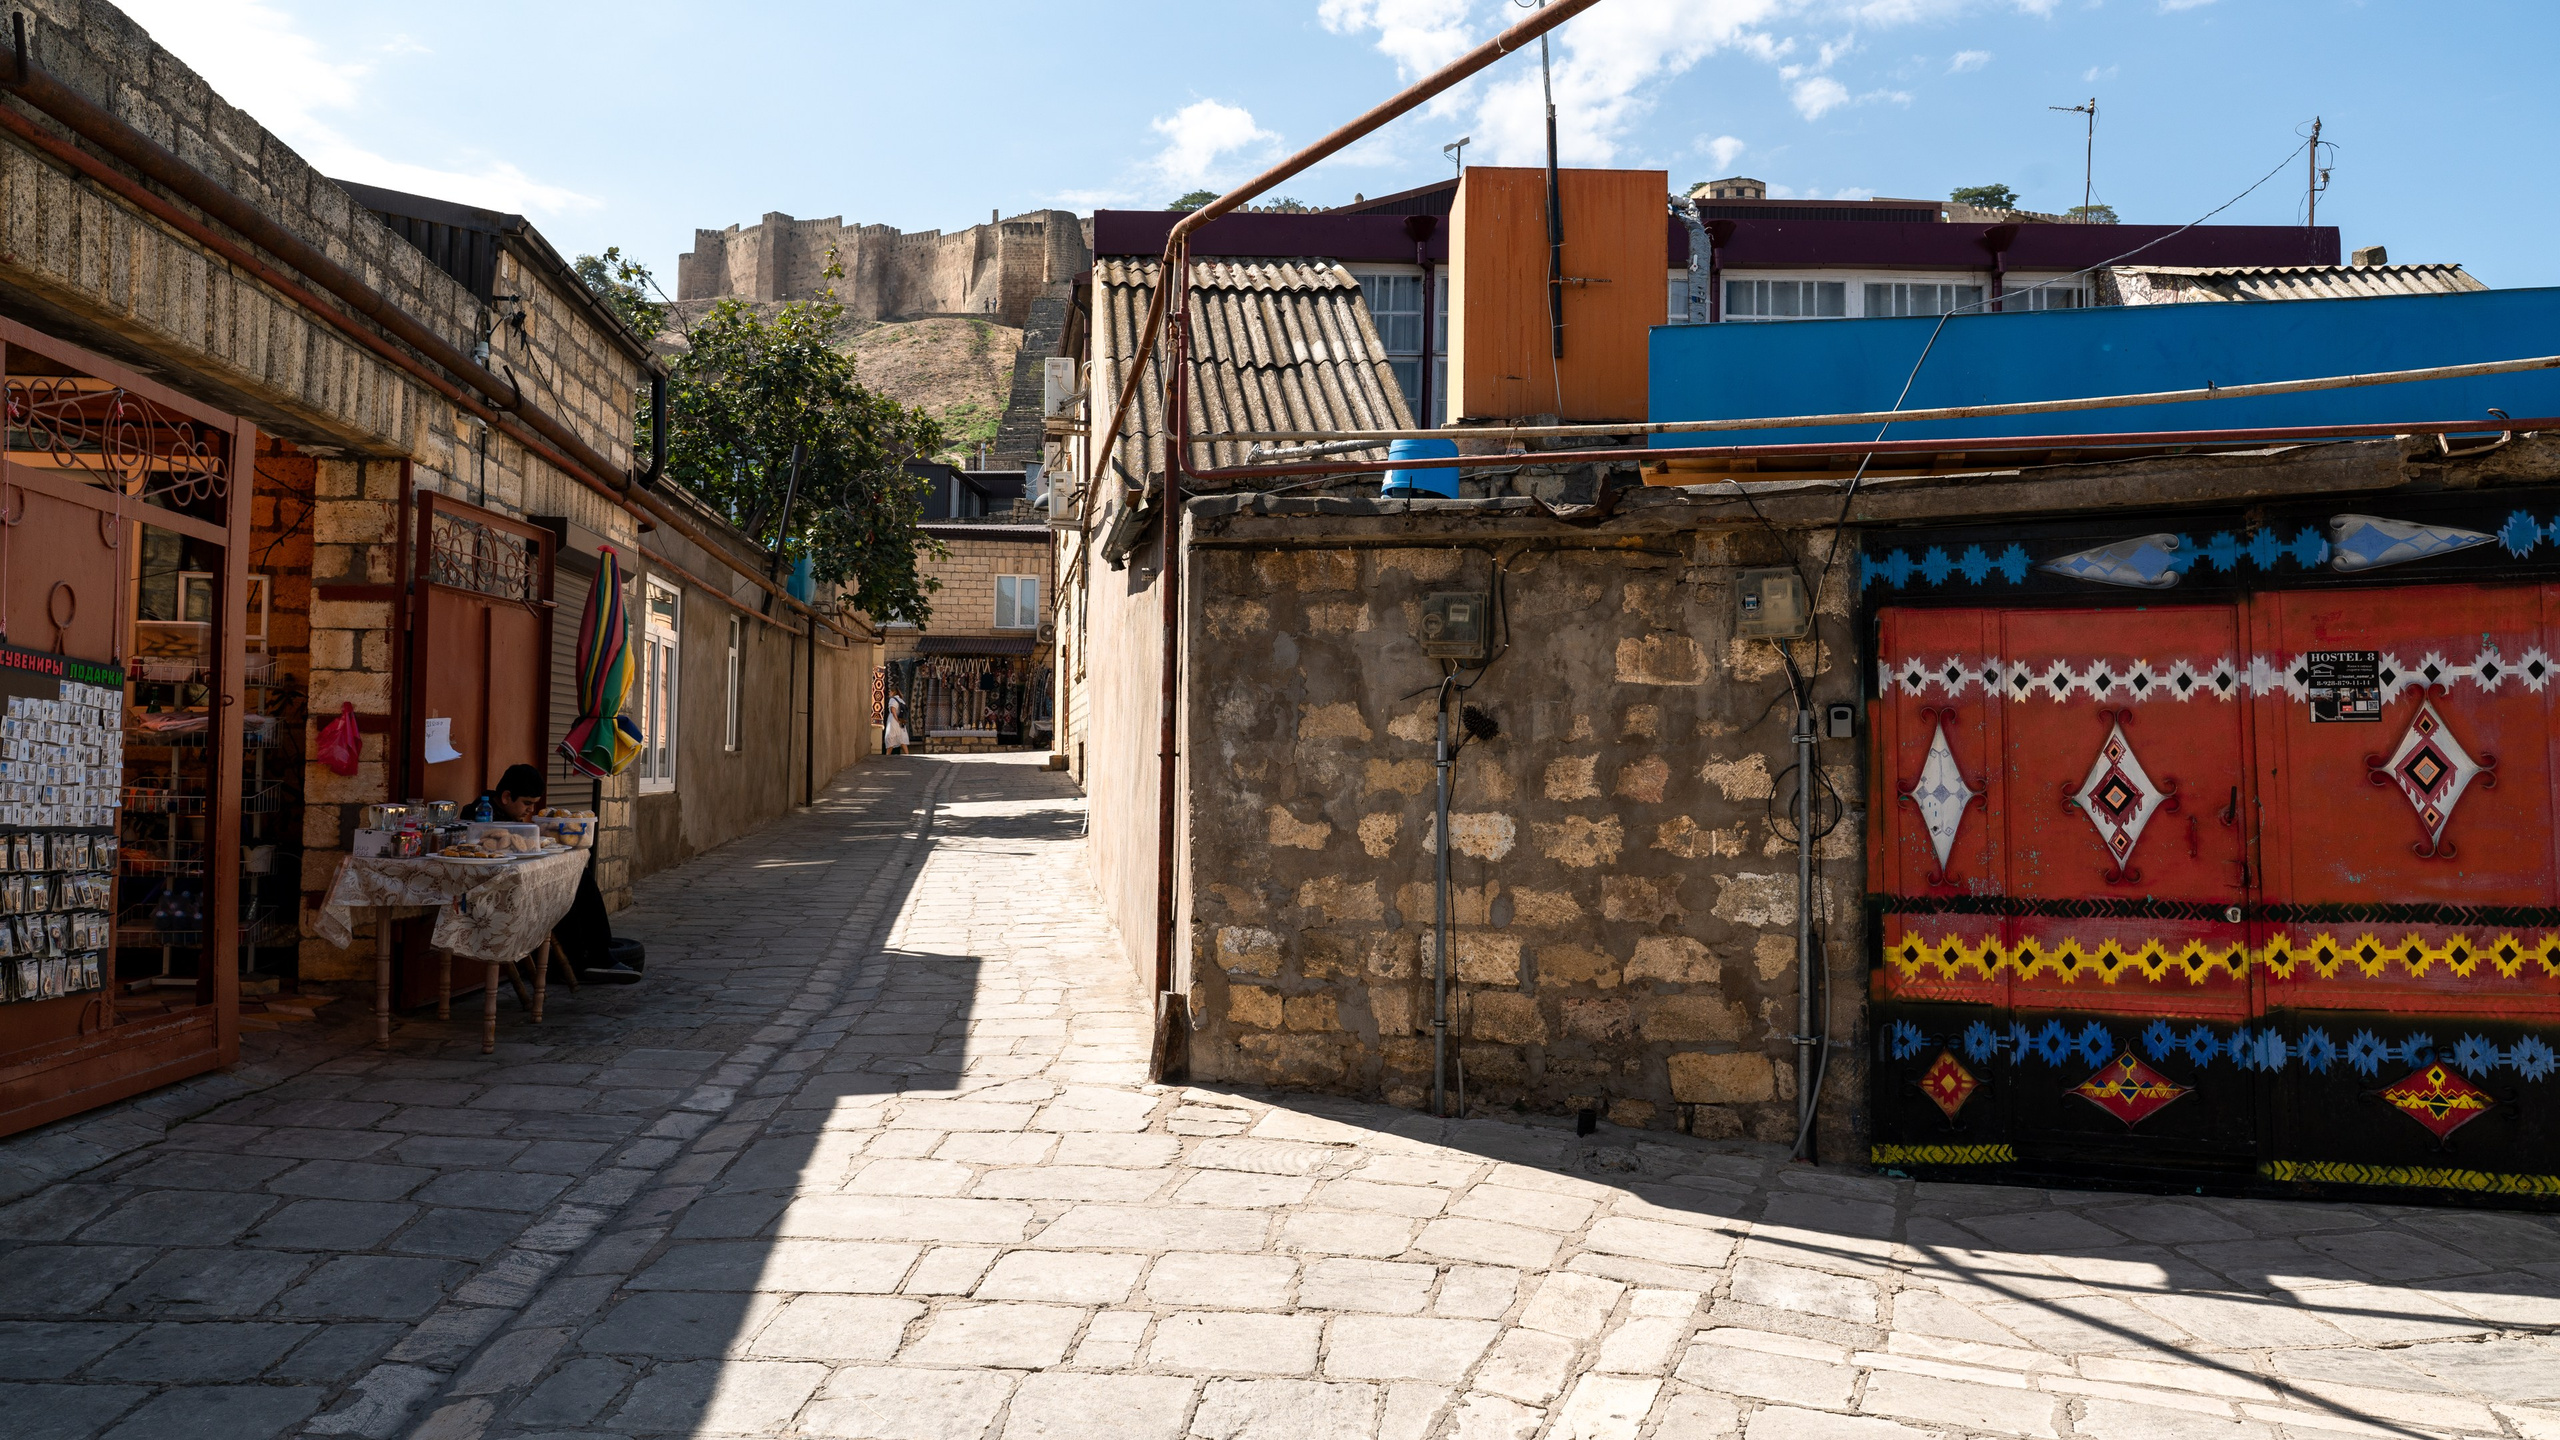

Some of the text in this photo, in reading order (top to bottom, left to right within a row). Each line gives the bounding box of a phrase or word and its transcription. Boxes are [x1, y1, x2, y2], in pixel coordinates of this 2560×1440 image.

[0, 649, 123, 686] СУВЕНИРЫ ПОДАРКИ
[2311, 652, 2375, 662] HOSTEL 8
